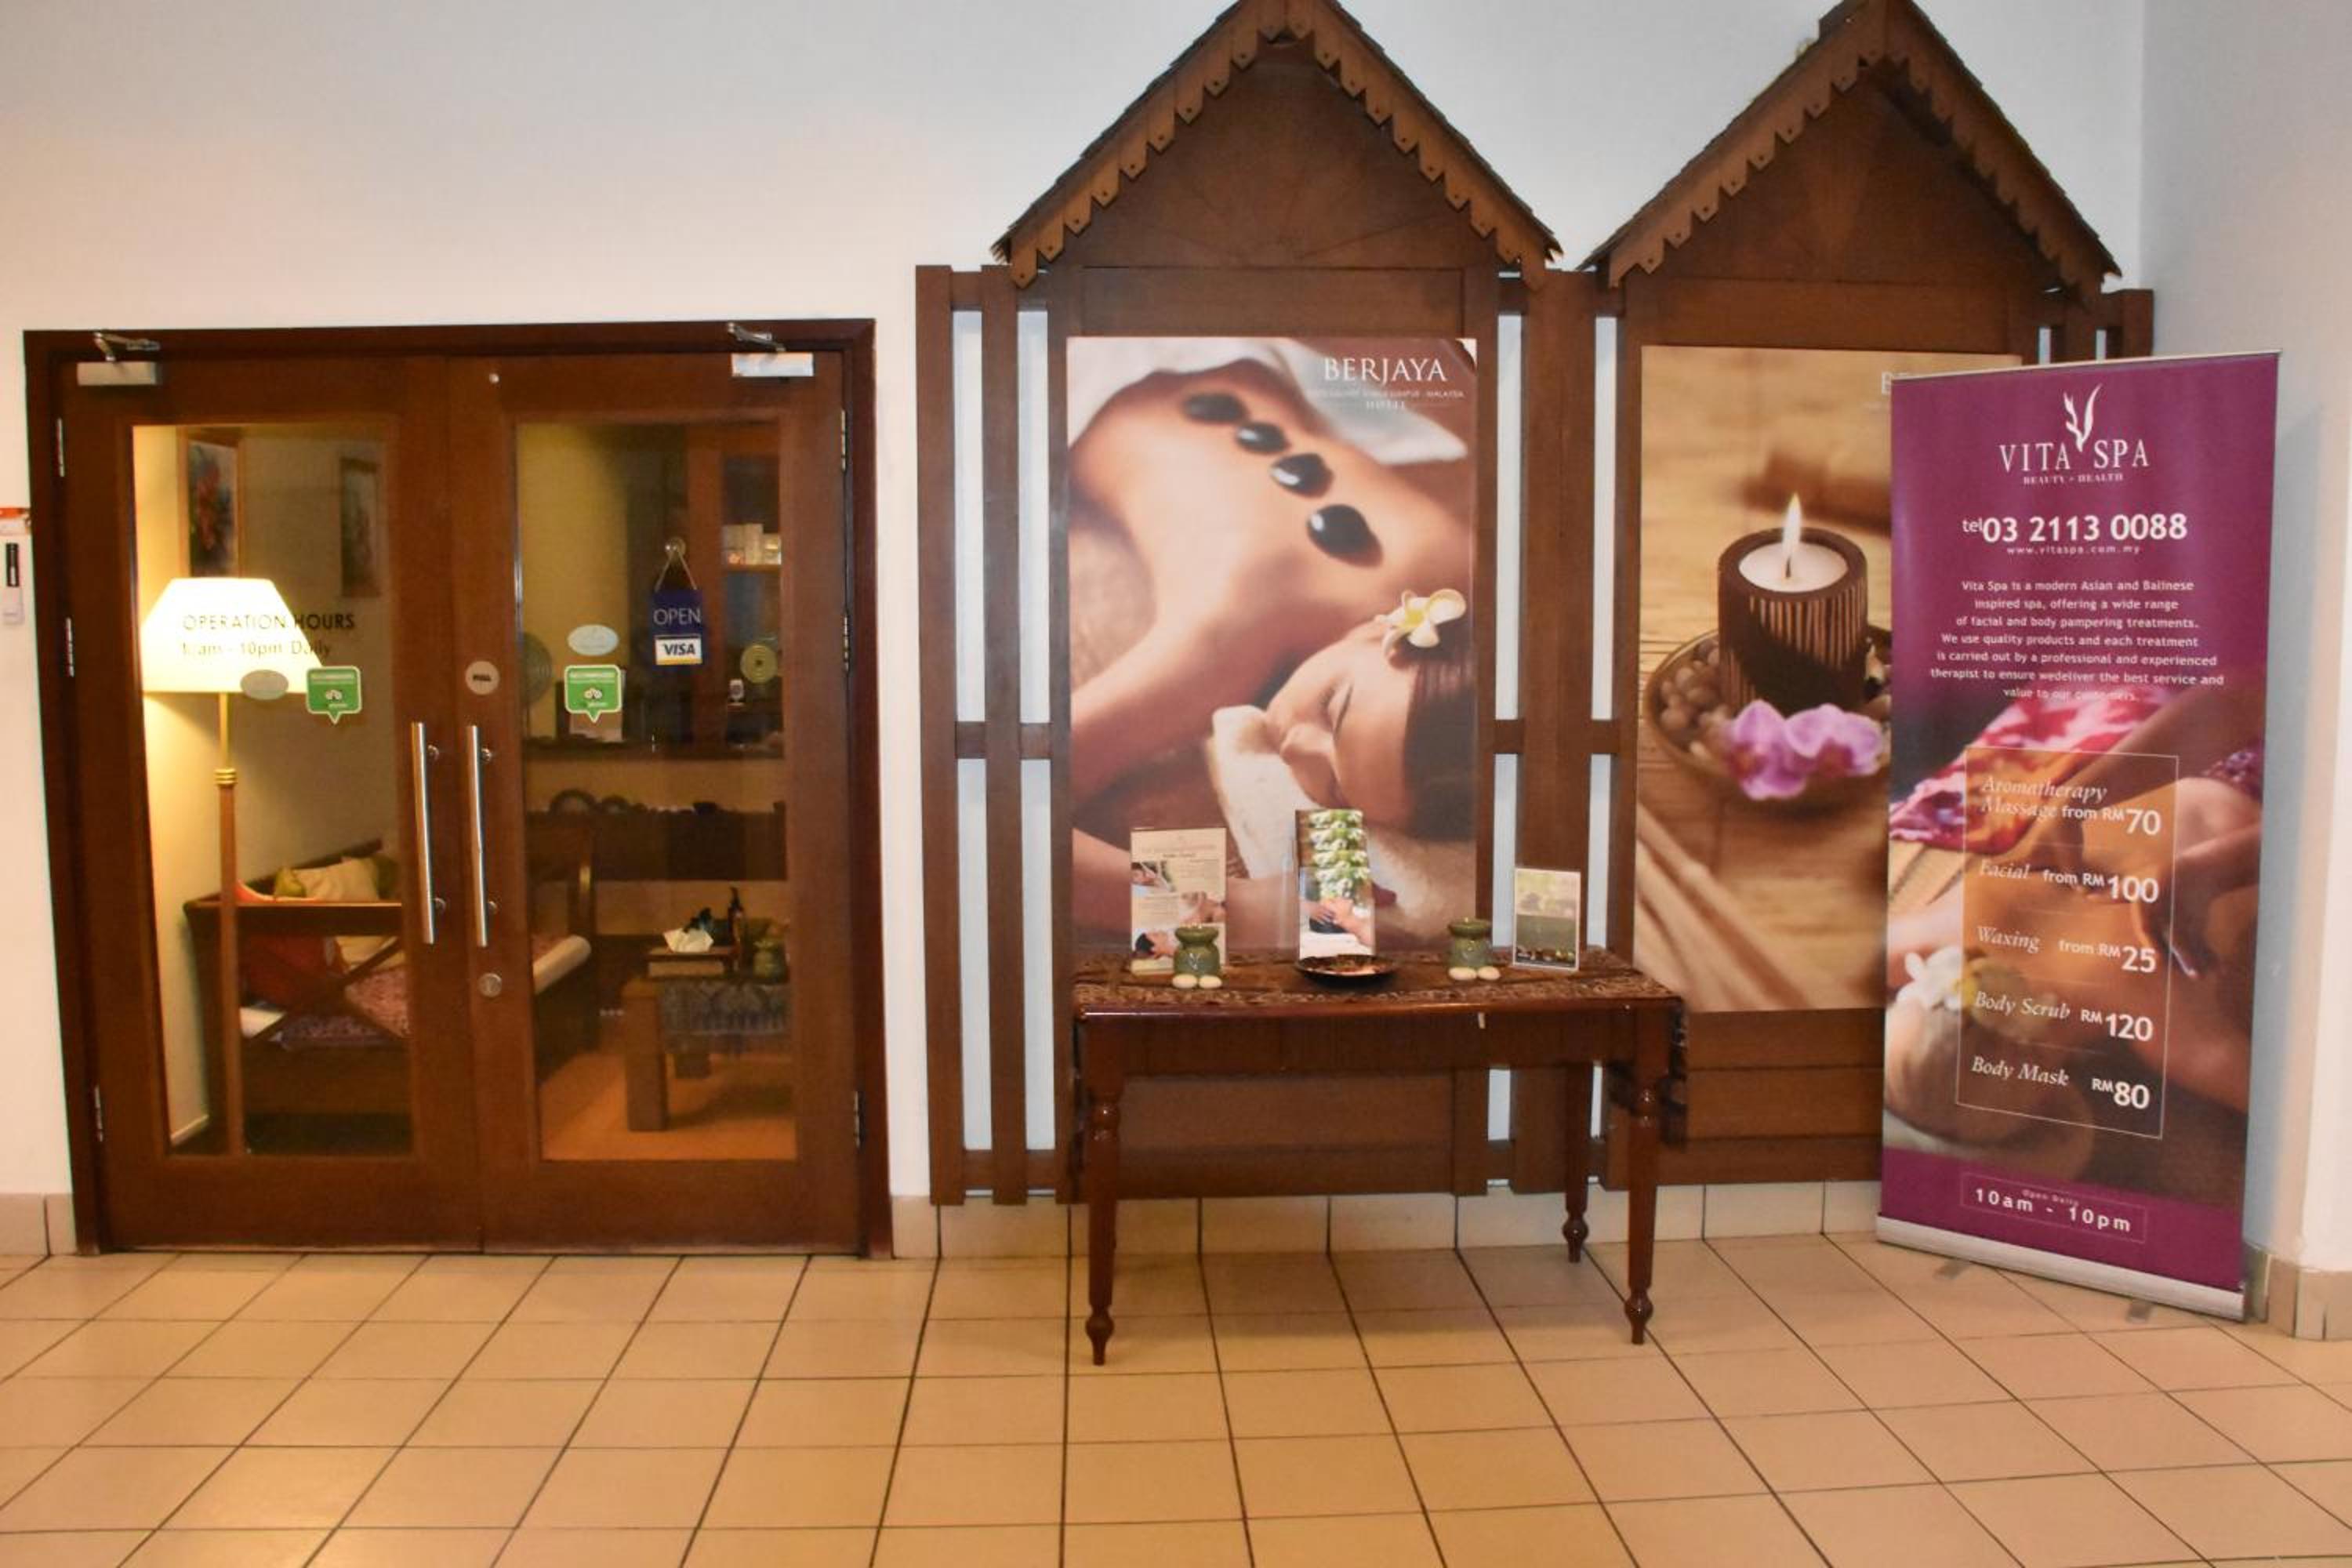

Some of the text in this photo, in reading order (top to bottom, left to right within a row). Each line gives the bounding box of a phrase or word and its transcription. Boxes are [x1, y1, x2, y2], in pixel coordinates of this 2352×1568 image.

[1323, 358, 1448, 386] BERJAYA
[1999, 439, 2150, 472] VITA SPA
[2078, 473, 2124, 484] HEALTH
[2029, 515, 2100, 542] 2113
[2110, 513, 2188, 540] 0088
[1962, 580, 1984, 591] Vita
[1987, 580, 2007, 592] Spa
[2012, 581, 2022, 590] is
[2035, 581, 2077, 591] modern
[2081, 581, 2113, 590] Asian
[2117, 581, 2139, 590] and
[2143, 580, 2194, 591] Balinese
[1975, 600, 2020, 611] inspired
[2050, 599, 2096, 612] offering
[2112, 600, 2140, 609] wide
[2144, 601, 2180, 612] range
[182, 614, 355, 630] OPERATION HOURS
[652, 608, 702, 626] OPEN
[1957, 616, 1968, 626] of
[1971, 616, 2002, 626] facial
[2006, 617, 2027, 626] and
[2031, 617, 2056, 628] body
[2060, 618, 2123, 629] pampering
[664, 642, 696, 656] VISA
[1941, 633, 2198, 647] We use quality products and each treatment
[182, 641, 223, 656] 1am
[240, 641, 283, 659] 10pm
[291, 640, 332, 659] Daily
[1937, 652, 1946, 661] is
[1948, 652, 1989, 662] carried
[1992, 652, 2010, 662] out
[2014, 652, 2027, 663] by
[2041, 652, 2111, 664] professional
[2115, 655, 2138, 664] and
[2140, 655, 2217, 666] experienced
[1931, 668, 1980, 681] therapist
[1984, 670, 1994, 679] to
[1998, 671, 2035, 680] ensure
[2100, 673, 2120, 683] the
[2124, 673, 2149, 684] best
[2153, 674, 2197, 685] service
[2200, 675, 2224, 685] and
[2004, 688, 2033, 698] value
[1981, 775, 2107, 803] Aromatherapy
[1981, 796, 2057, 821] Massage
[2062, 806, 2097, 820] from
[1980, 859, 2031, 879] Facial
[2043, 869, 2078, 885] from
[1978, 926, 2040, 953] Waxing
[2059, 938, 2094, 955] from
[1975, 990, 2016, 1016] Body
[2021, 997, 2071, 1019] Scrub
[1972, 1055, 2013, 1080] Body
[2018, 1063, 2070, 1087] Mask
[1975, 1188, 2033, 1212] 10am
[2069, 1206, 2131, 1233] 10pm
